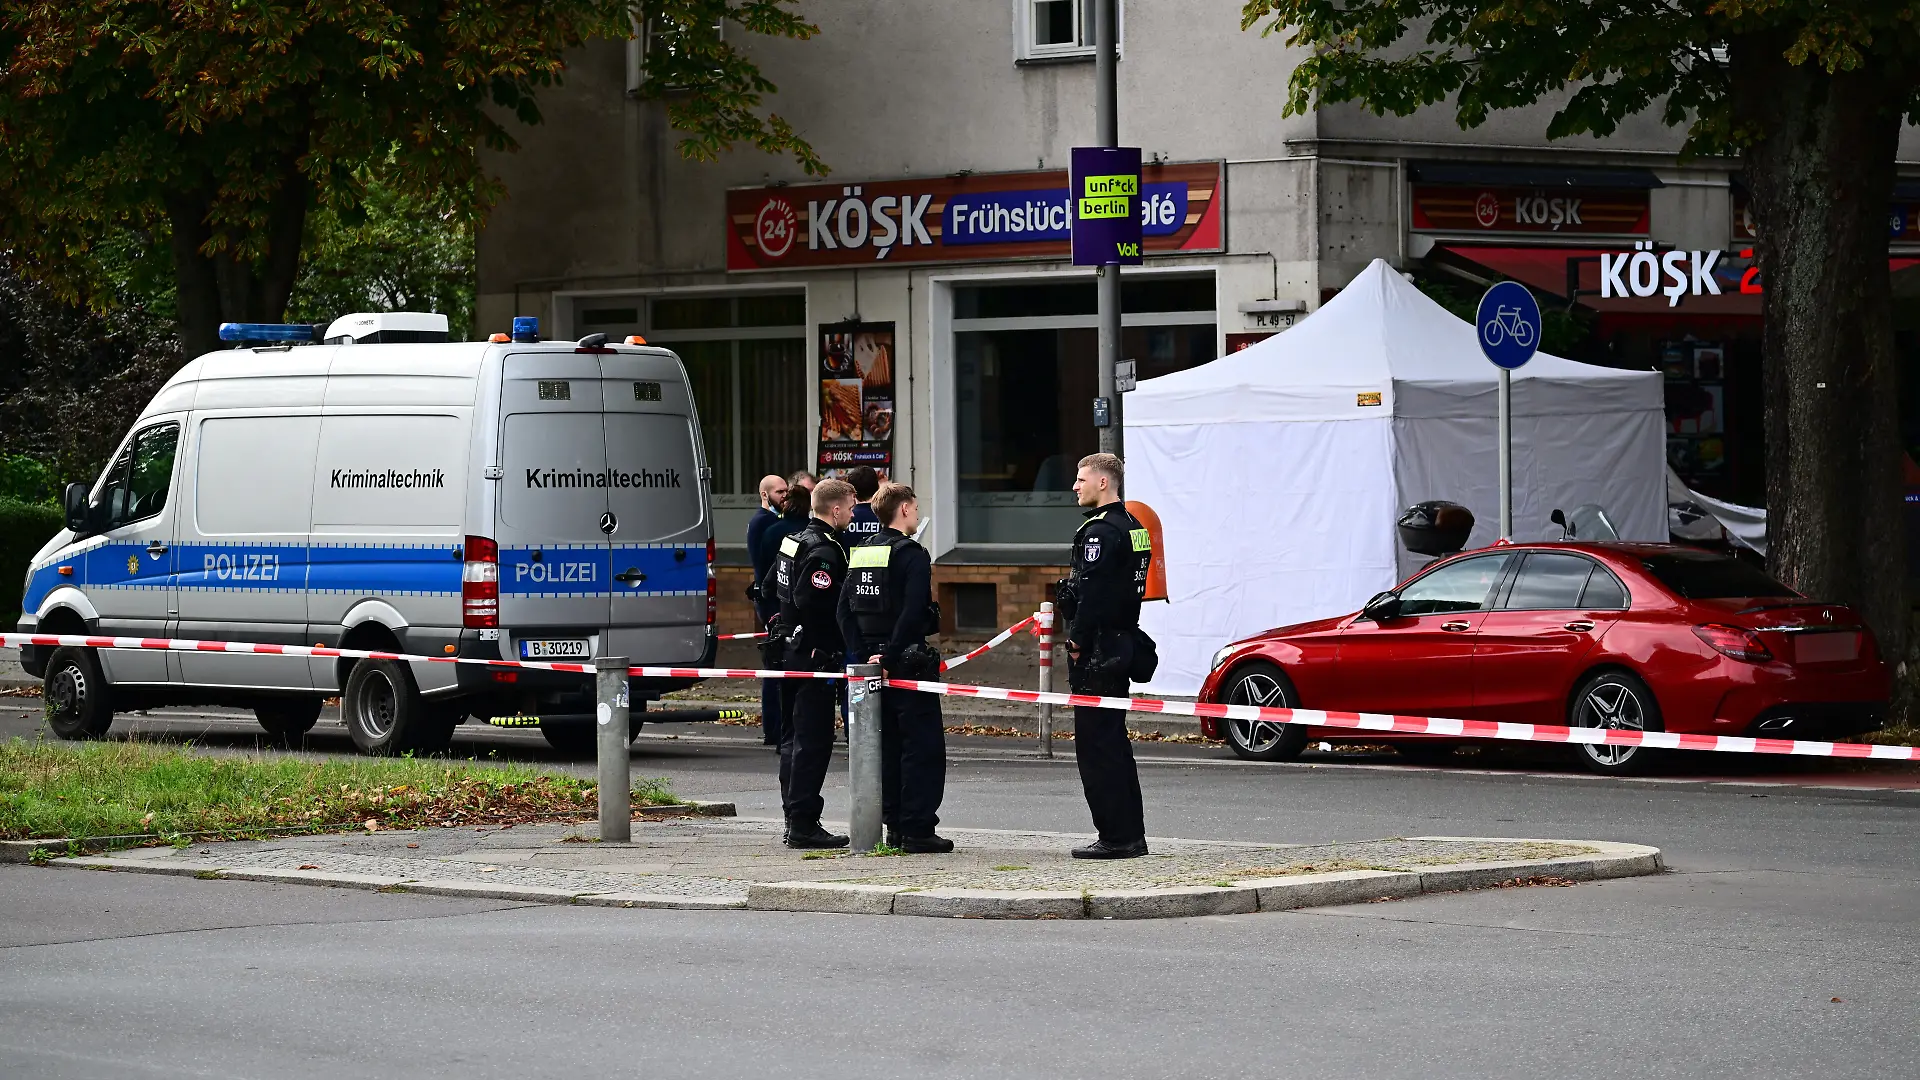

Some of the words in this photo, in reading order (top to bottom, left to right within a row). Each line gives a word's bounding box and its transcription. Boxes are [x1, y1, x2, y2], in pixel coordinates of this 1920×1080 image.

[1084, 201, 1126, 215] berlin
[1480, 204, 1493, 216] 24
[1515, 190, 1582, 231] KÖŞK
[764, 219, 786, 239] 24
[808, 186, 933, 259] KÖŞK
[1141, 192, 1176, 226] afé
[1116, 242, 1139, 257] Volt
[1601, 240, 1722, 307] KÖŞK
[1257, 315, 1267, 326] PL
[330, 468, 444, 489] Kriminaltechnik
[526, 467, 681, 489] Kriminaltechnik
[847, 522, 880, 533] OLIZEI
[204, 554, 279, 581] POLIZEI
[516, 563, 596, 582] POLIZEI
[861, 572, 873, 583] BE
[855, 585, 880, 596] 36216
[532, 642, 541, 655] B
[548, 642, 583, 655] 30219
